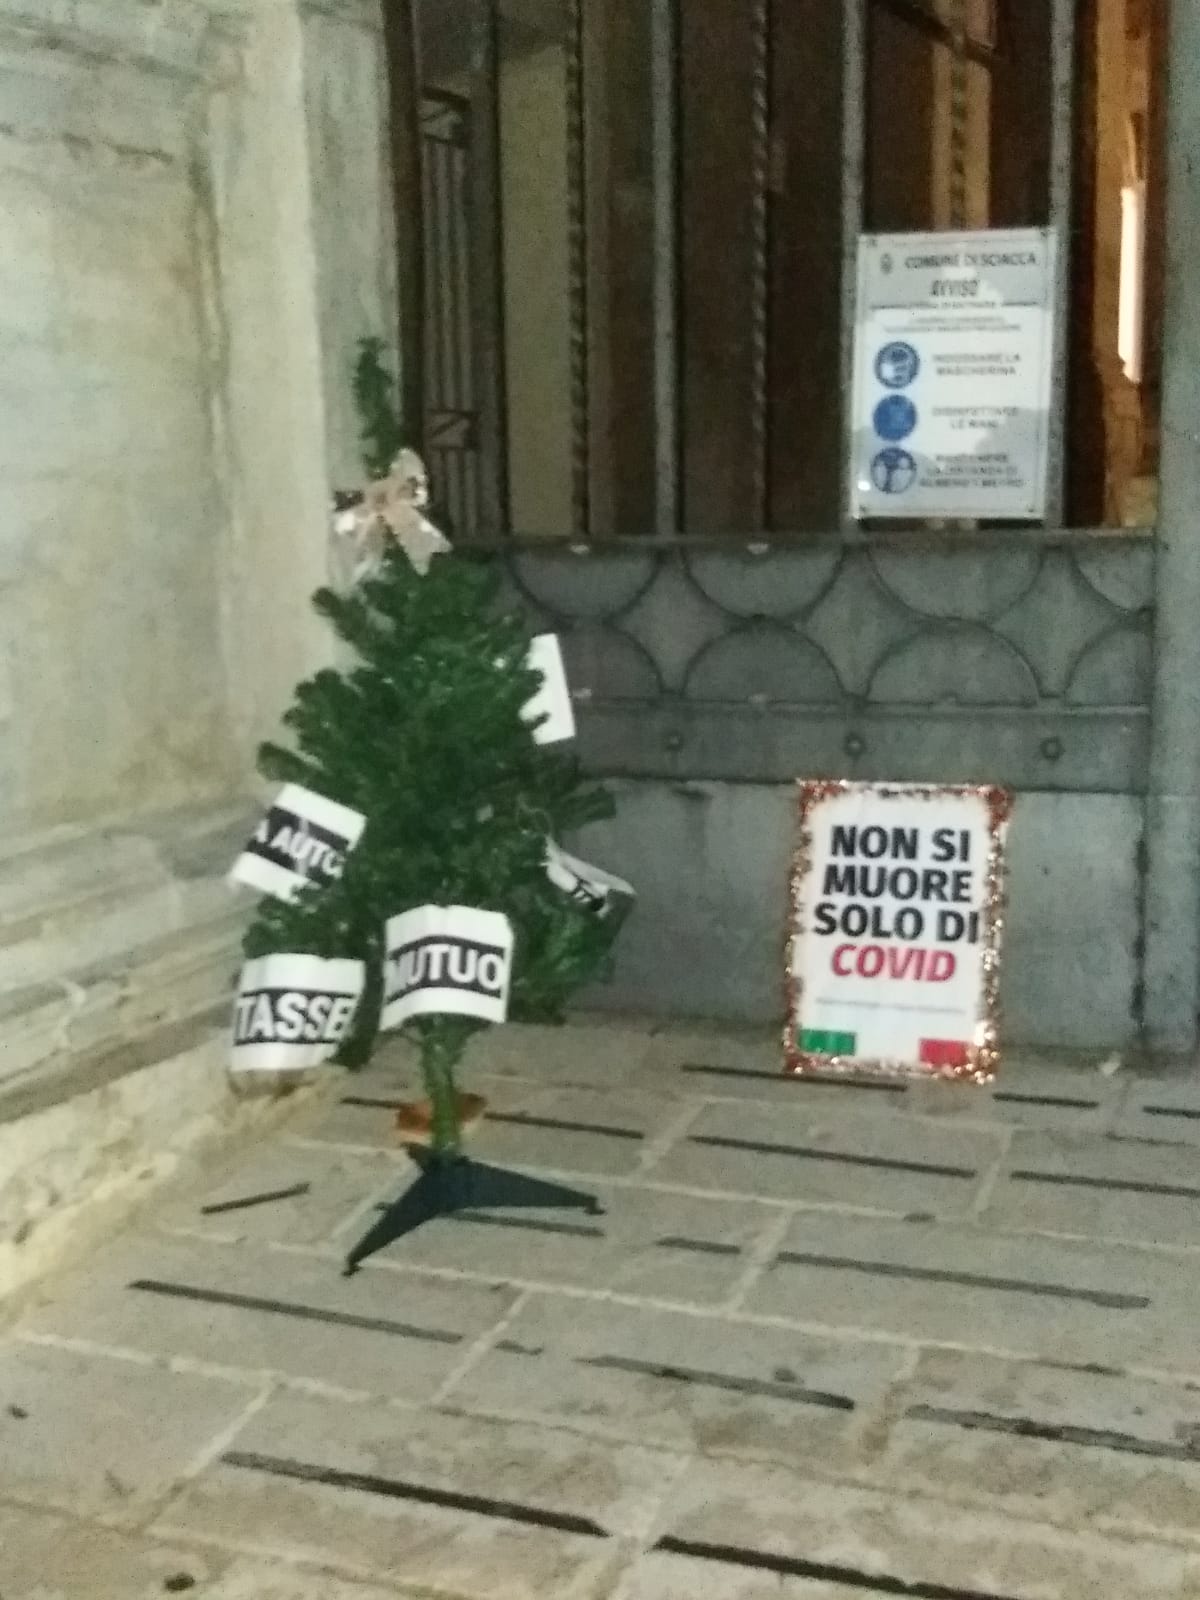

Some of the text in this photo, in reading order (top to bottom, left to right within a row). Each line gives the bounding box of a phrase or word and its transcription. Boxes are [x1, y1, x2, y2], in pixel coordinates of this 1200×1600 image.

[904, 254, 960, 269] COMUNE
[930, 279, 979, 297] AVVISO
[830, 824, 971, 862] NON SI
[822, 864, 973, 903] MUORE
[812, 903, 980, 943] SOLO DI
[831, 943, 957, 982] COVID
[235, 991, 359, 1041] TASSE
